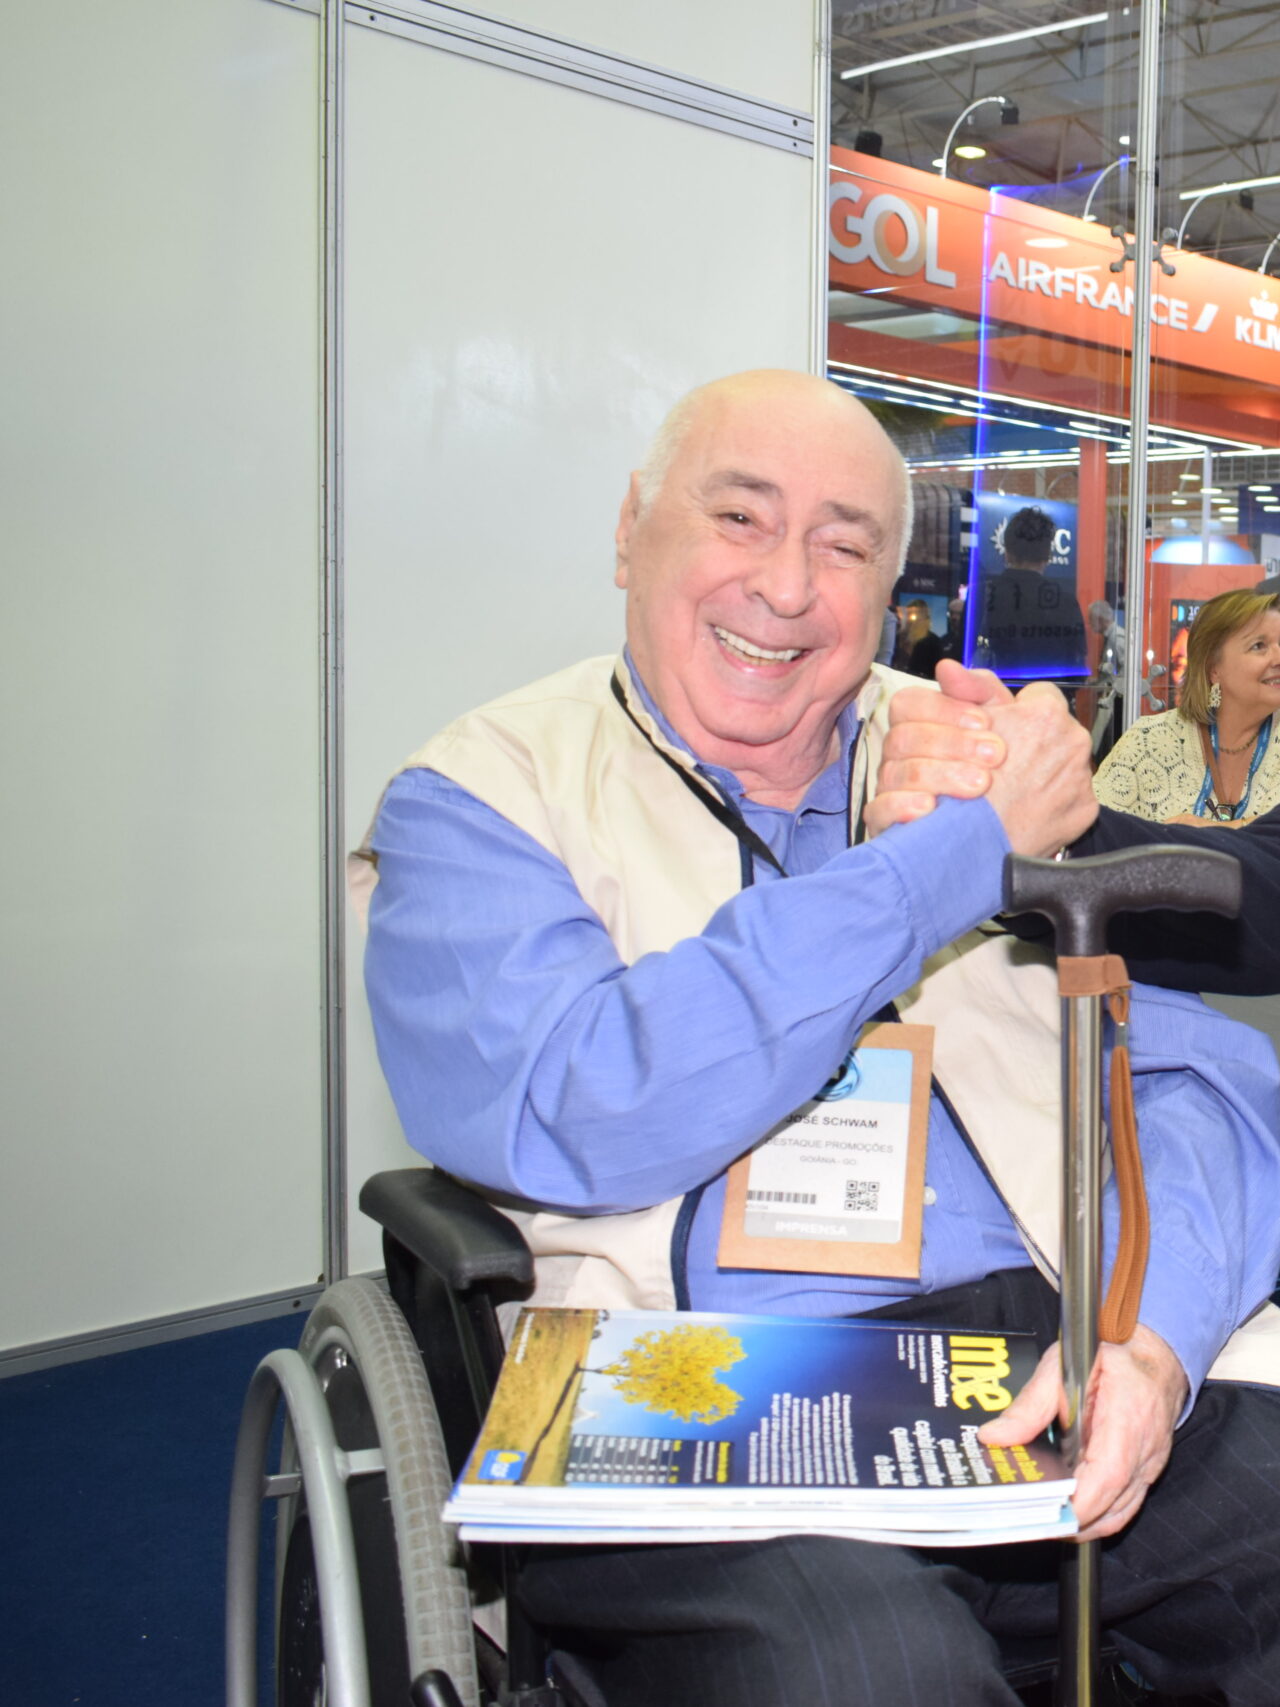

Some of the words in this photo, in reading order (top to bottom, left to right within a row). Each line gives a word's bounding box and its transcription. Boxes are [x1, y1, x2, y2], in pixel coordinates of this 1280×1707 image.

[829, 180, 956, 288] GOL
[822, 1116, 878, 1128] SCHWAM
[765, 1137, 822, 1149] DESTAQUE
[825, 1140, 894, 1153] PROMOÇÕES
[775, 1221, 848, 1236] IMPRENSA
